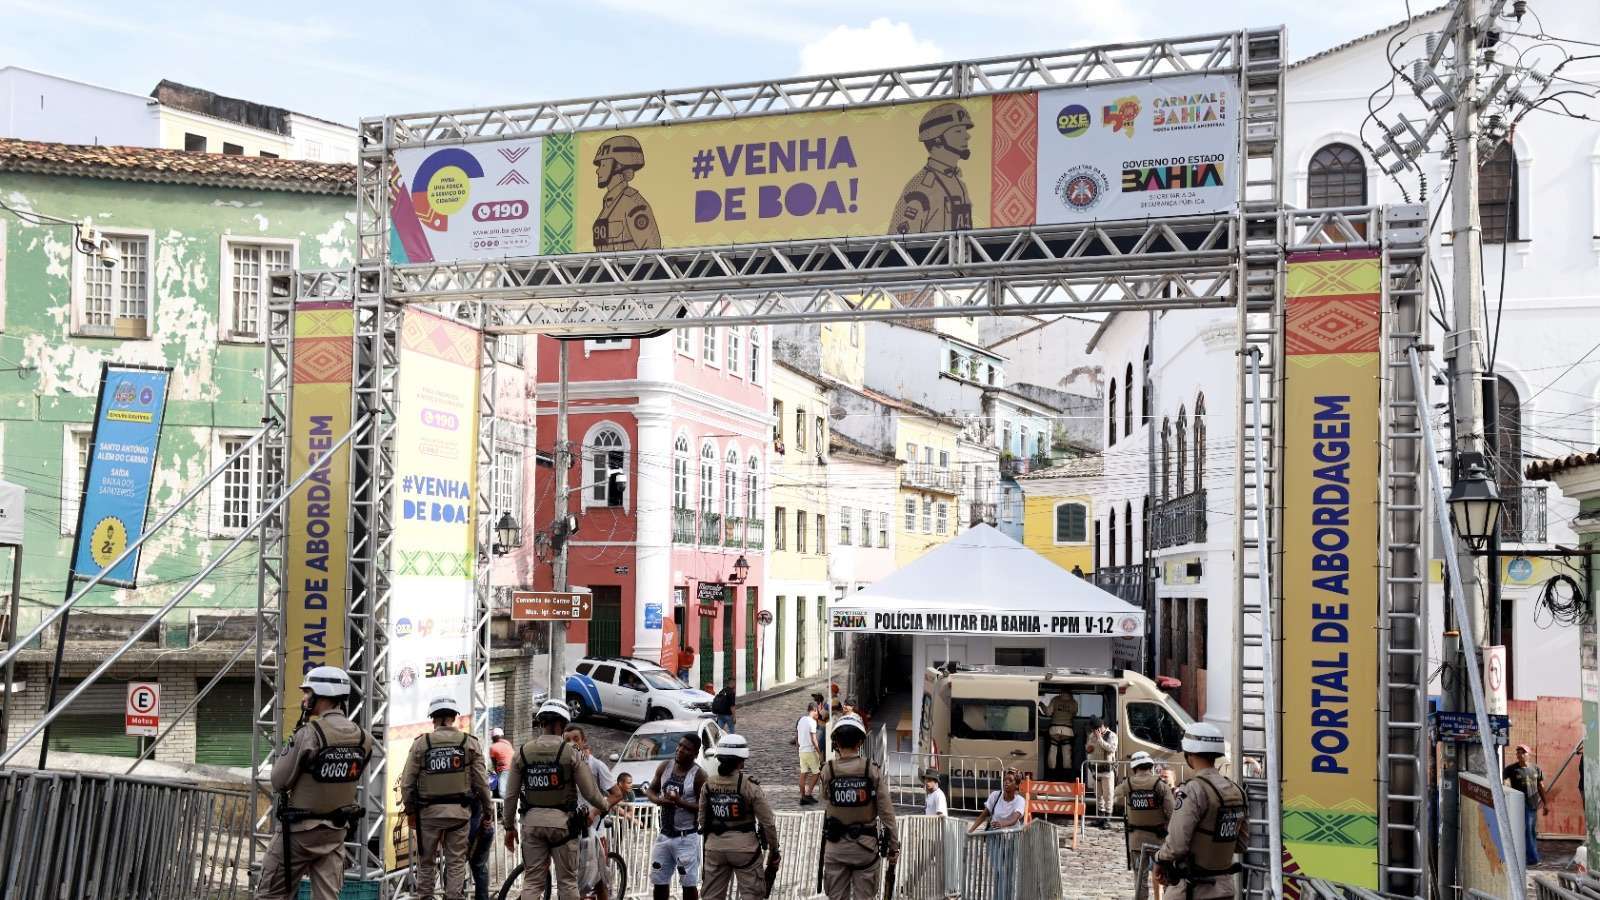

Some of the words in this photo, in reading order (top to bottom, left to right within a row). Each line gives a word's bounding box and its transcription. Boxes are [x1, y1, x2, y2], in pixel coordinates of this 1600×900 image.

[1152, 93, 1217, 108] CARNAVAL
[1058, 113, 1088, 125] OXE
[1153, 105, 1217, 126] BAHIA
[692, 135, 857, 179] #VENHA
[1122, 158, 1169, 169] GOVERNO
[1171, 156, 1186, 166] DO
[1187, 153, 1225, 165] ESTADO
[1121, 163, 1224, 193] BAHIA
[695, 187, 747, 223] DE
[758, 178, 859, 218] BOA!
[492, 203, 523, 218] 190
[306, 415, 334, 573] ABORDAGEM
[402, 474, 471, 501] #VENHA
[1312, 395, 1351, 596] ABORDAGEM
[403, 500, 427, 521] DE
[430, 502, 471, 525] BOA!
[305, 578, 329, 610] DE
[833, 615, 867, 628] BAHIA
[875, 610, 923, 630] POLÍCIA
[926, 613, 977, 631] MILITAR
[981, 614, 998, 632] DA
[1001, 615, 1041, 633] BAHIA
[1051, 616, 1080, 634] PPM
[1085, 616, 1114, 634] V-1.2
[1312, 603, 1349, 643] DE
[425, 660, 468, 678] BAHIA
[138, 692, 148, 708] E
[1311, 652, 1350, 774] PORTAL
[321, 761, 349, 778] 0060
[350, 761, 359, 777] A
[430, 757, 451, 770] 0061
[527, 775, 549, 787] 0060
[550, 774, 559, 786] B
[834, 790, 857, 802] 0060
[859, 789, 867, 802] D
[731, 804, 739, 817] E
